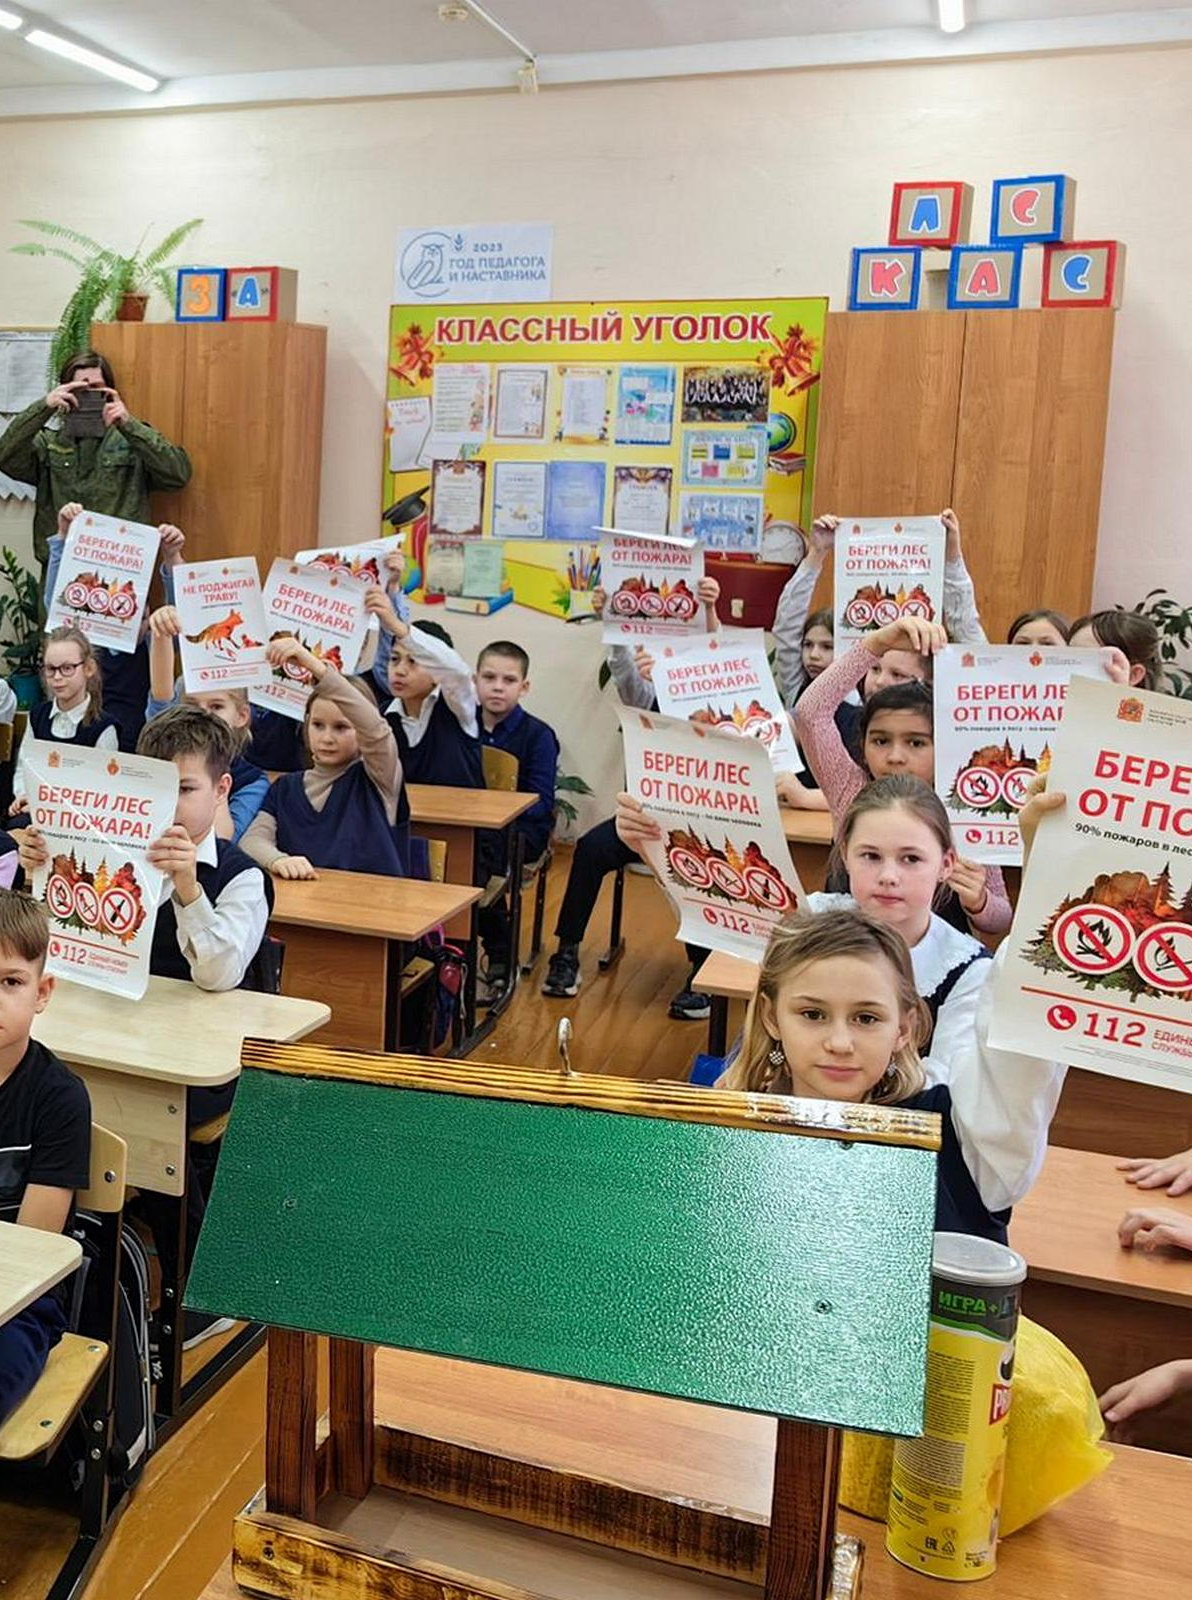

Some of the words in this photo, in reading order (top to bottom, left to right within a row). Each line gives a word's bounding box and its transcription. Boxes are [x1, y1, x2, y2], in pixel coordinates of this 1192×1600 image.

[1012, 189, 1040, 226] С
[473, 243, 503, 252] 2023
[449, 258, 475, 270] ГОД
[478, 256, 546, 269] ПЕДАГОГА
[449, 272, 458, 282] И
[461, 269, 546, 282] НАСТАВНИКА
[869, 259, 905, 297] К
[967, 259, 1001, 296] А
[1062, 255, 1092, 292] С
[186, 275, 211, 314] 3
[435, 311, 623, 344] КЛАССНЫЙ
[633, 314, 772, 342] УГОЛОК
[78, 534, 120, 550] БЕРЕГИ
[121, 543, 144, 556] ЛЕС
[848, 544, 899, 556] БЕРЕГИ
[902, 544, 928, 555] ЛЕС
[74, 546, 89, 556] ОТ
[90, 548, 143, 570] ПОЖАРА!
[612, 551, 628, 561] ОТ
[632, 552, 692, 565] ПОЖАРА!
[845, 560, 865, 570] ОТ
[866, 558, 931, 570] ПОЖАРА!
[182, 585, 196, 594] НЕ
[198, 577, 255, 593] ПОДЖИГАЙ
[204, 592, 239, 604] ТРАВУ!
[278, 583, 329, 610] БЕРЕГИ
[330, 600, 357, 617] ЛЕС
[271, 597, 291, 612] ОТ
[292, 602, 355, 633] ПОЖАРА!
[211, 668, 228, 680] 112
[667, 661, 720, 681] БЕРЕГИ
[723, 658, 751, 672] ЛЕС
[265, 684, 287, 699] 112
[668, 683, 689, 696] ОТ
[691, 673, 759, 693] ПОЖАРА!
[958, 684, 1037, 701] БЕРЕГИ
[1043, 684, 1069, 700] ЛЕ
[953, 706, 983, 722] ОТ
[643, 750, 708, 779] БЕРЕГИ
[713, 762, 751, 787] ЛЕС
[38, 784, 109, 810] БЕРЕГИ
[112, 795, 153, 817] ЛЕС
[640, 777, 663, 799] ОТ
[667, 782, 760, 816] ПОЖАРА!
[1078, 788, 1135, 822] ОТ
[36, 808, 56, 825] ОТ
[60, 811, 152, 840] ПОЖАРА!
[986, 832, 1019, 846] 112
[1075, 822, 1102, 837] 90%
[1103, 829, 1159, 850] пожаров
[1162, 842, 1170, 851] в
[719, 913, 752, 935] 112
[61, 944, 87, 965] 112
[1083, 1013, 1147, 1048] 112
